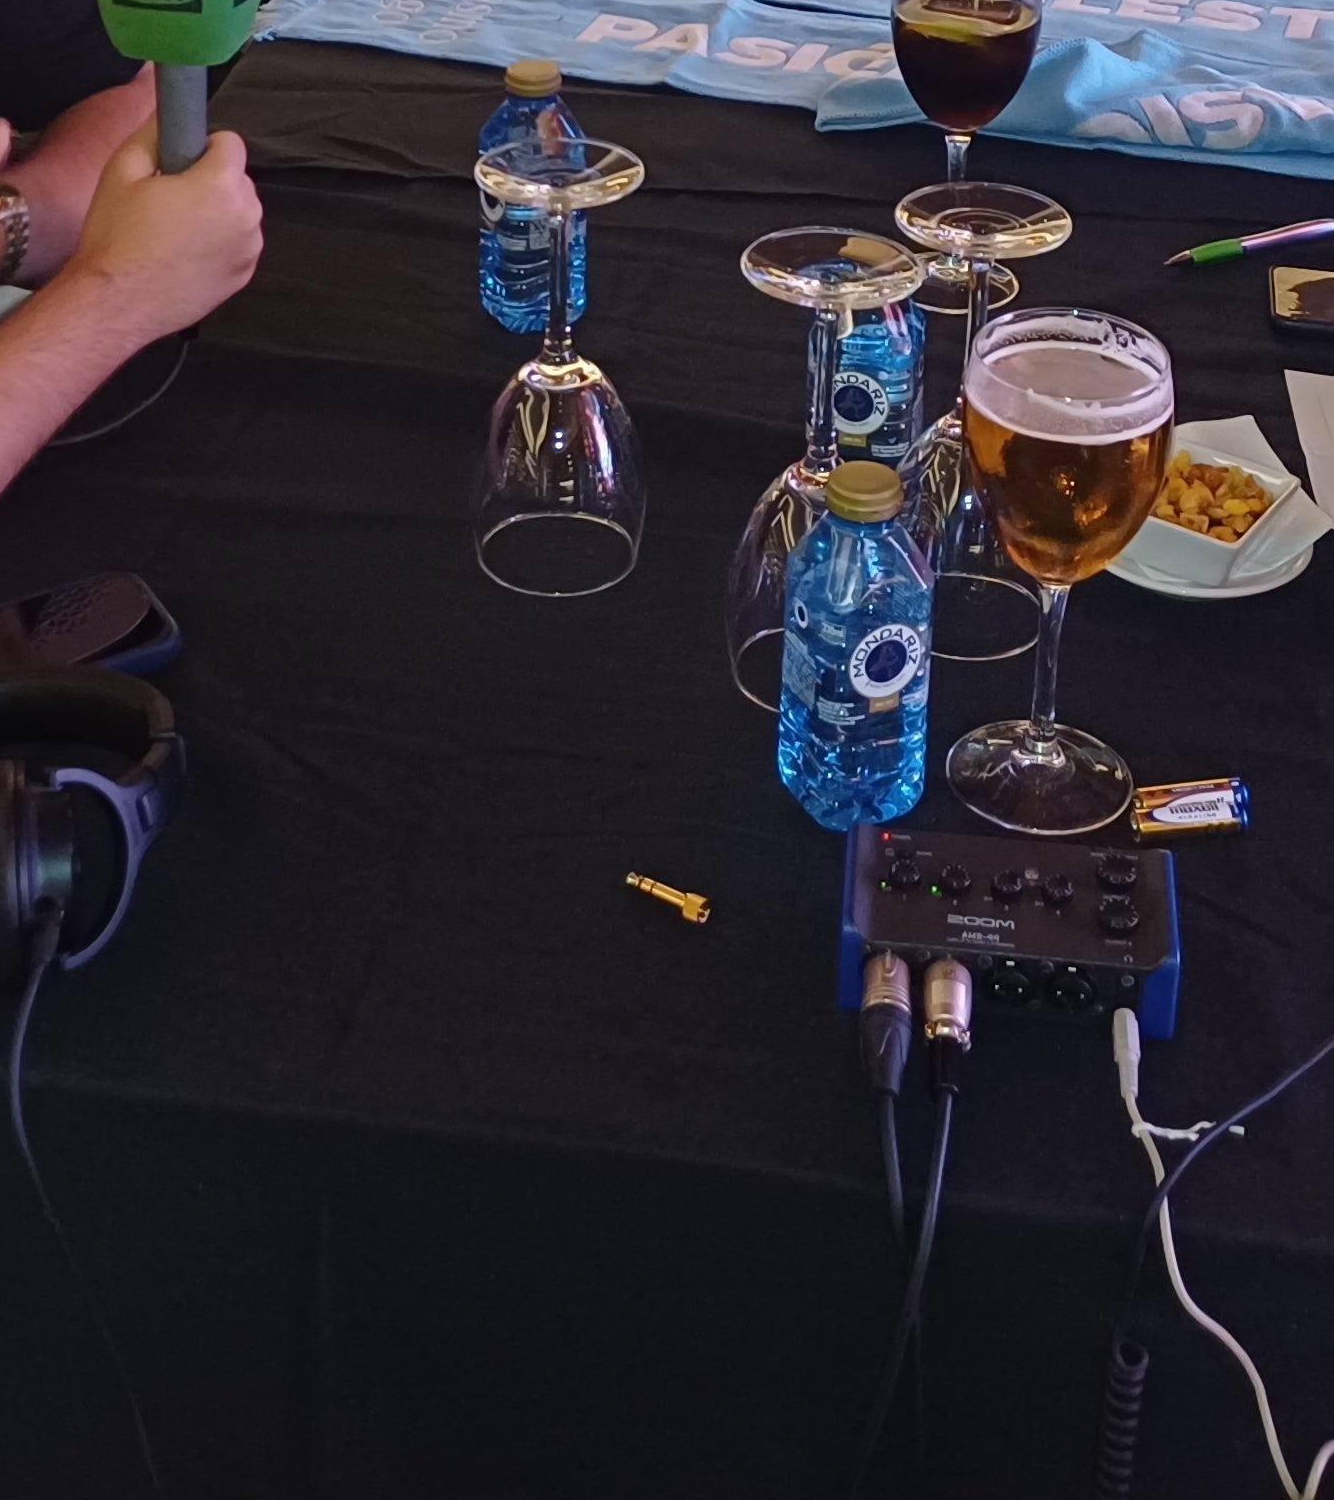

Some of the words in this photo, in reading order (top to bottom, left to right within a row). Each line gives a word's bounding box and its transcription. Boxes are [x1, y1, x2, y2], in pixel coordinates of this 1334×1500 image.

[833, 374, 886, 417] NDARIZ
[852, 627, 917, 679] MONDARIZ
[947, 913, 1015, 930] ZOOM
